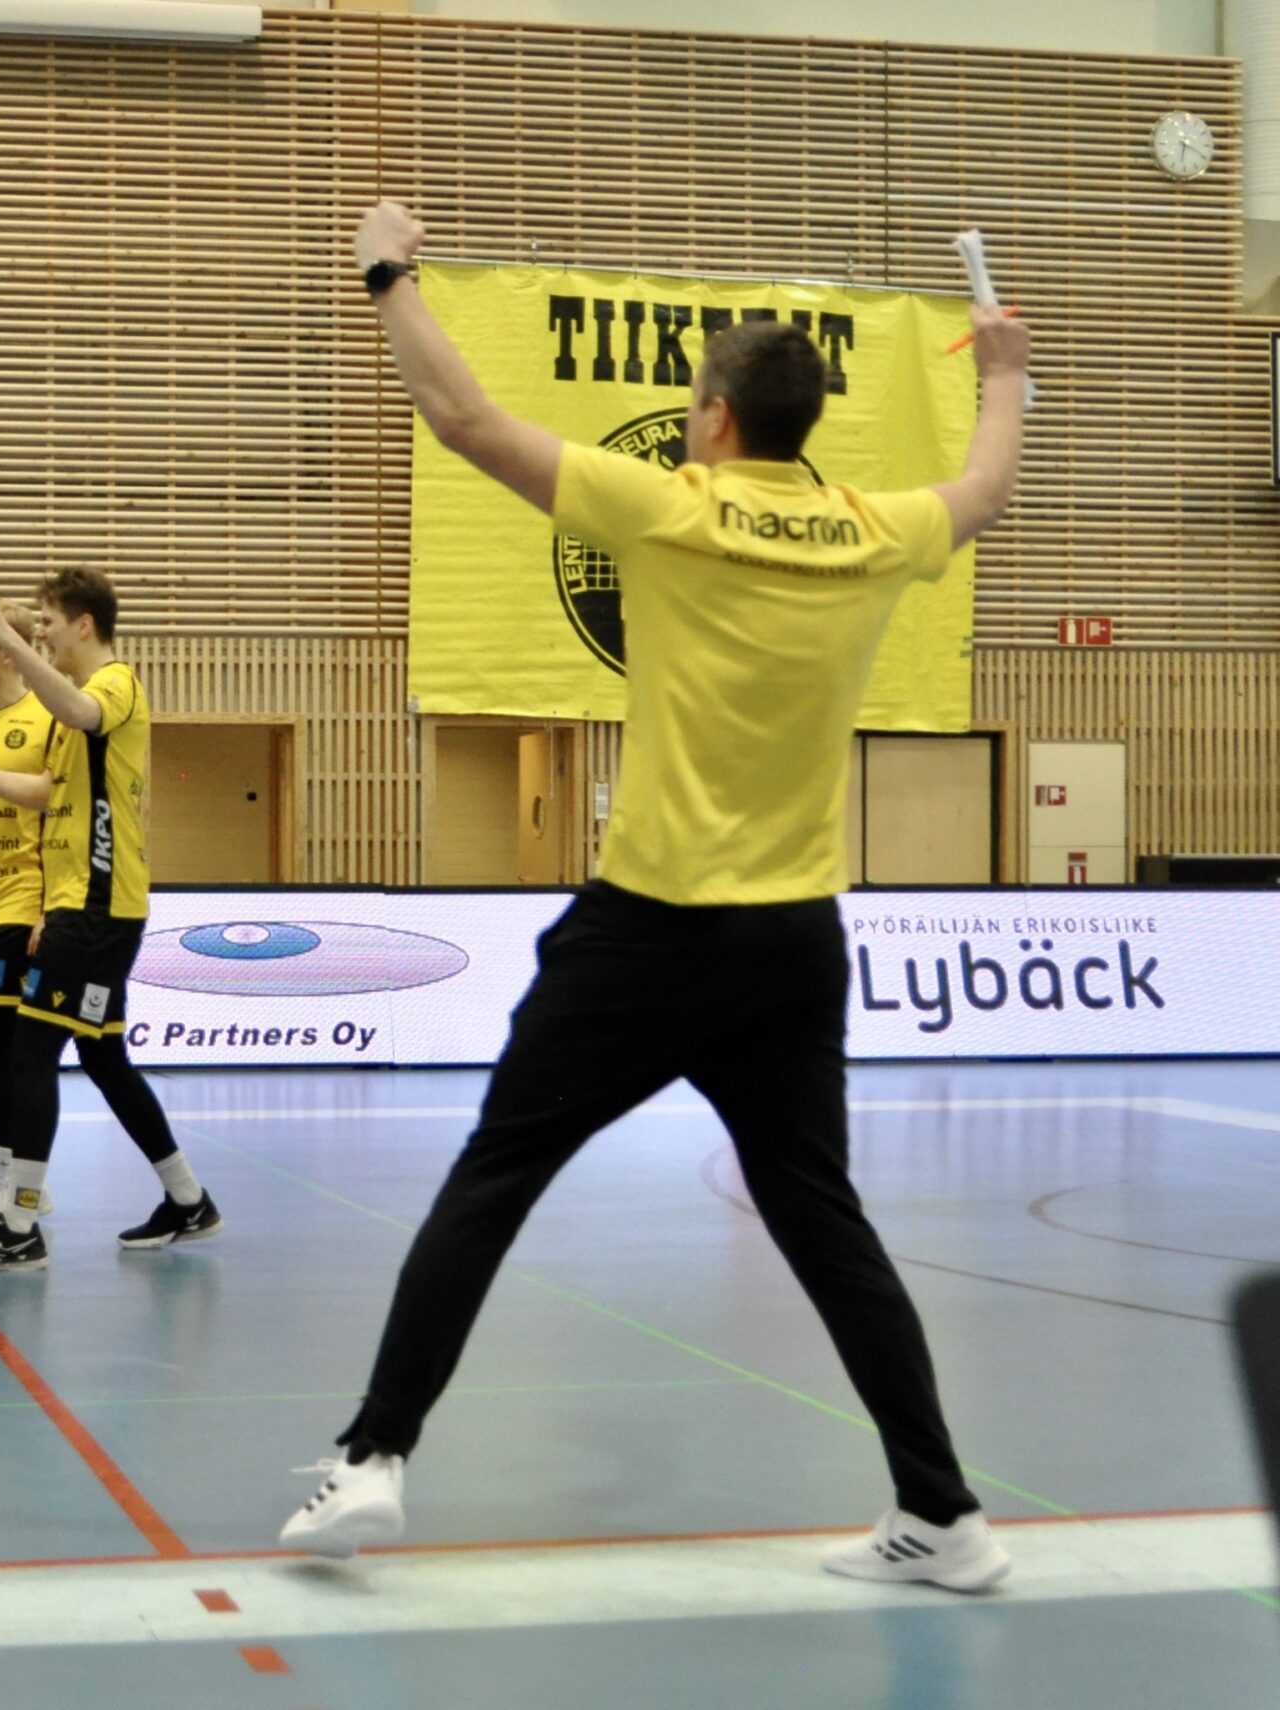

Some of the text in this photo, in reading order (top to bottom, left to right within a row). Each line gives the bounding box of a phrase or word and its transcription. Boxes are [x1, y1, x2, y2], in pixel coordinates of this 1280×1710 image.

[549, 294, 854, 396] TIIKT
[719, 501, 861, 546] macron
[853, 914, 1158, 935] PYÖRÄILIJÄN ERIKOISLIIKE
[857, 938, 1166, 1033] Lybäck
[162, 1022, 318, 1047] Partners
[332, 1021, 377, 1052] Oy
